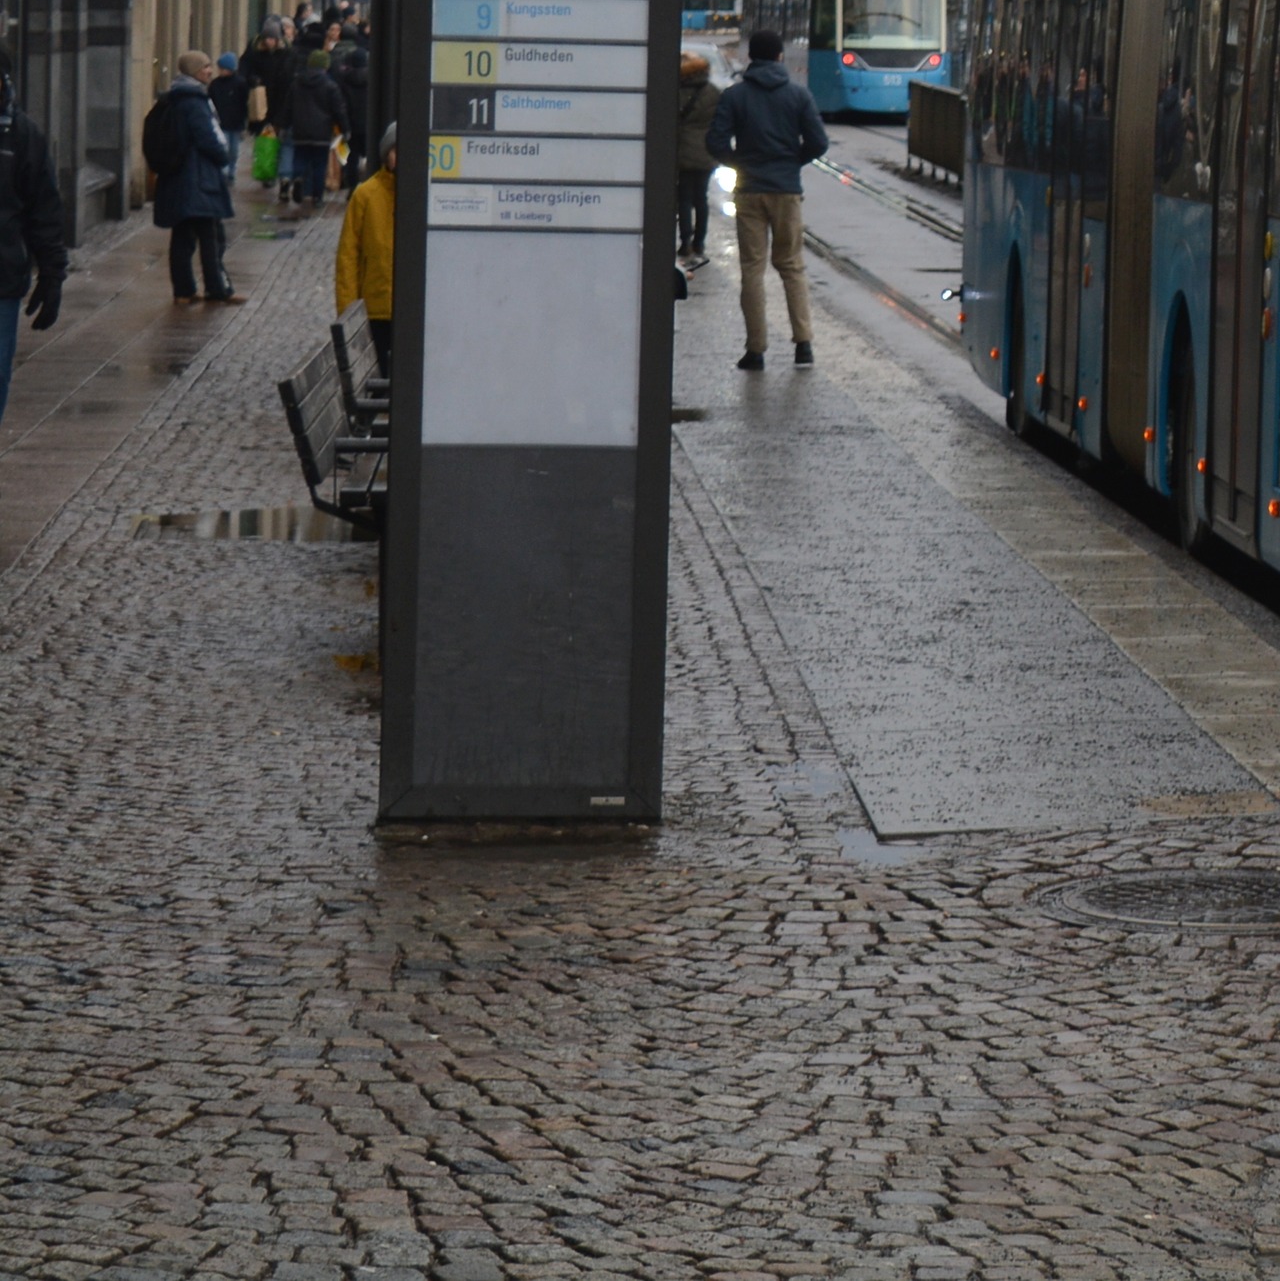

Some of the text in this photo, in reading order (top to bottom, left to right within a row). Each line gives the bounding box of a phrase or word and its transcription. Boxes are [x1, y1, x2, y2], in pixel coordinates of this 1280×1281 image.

[476, 2, 572, 30] 9 Kungssten
[464, 47, 574, 78] 10 Guldheden
[468, 95, 571, 125] 11 Saltholmen
[467, 140, 540, 156] Fredriksdal
[498, 190, 601, 207] Lisebergslinjen
[500, 212, 552, 222] till Liseberg
